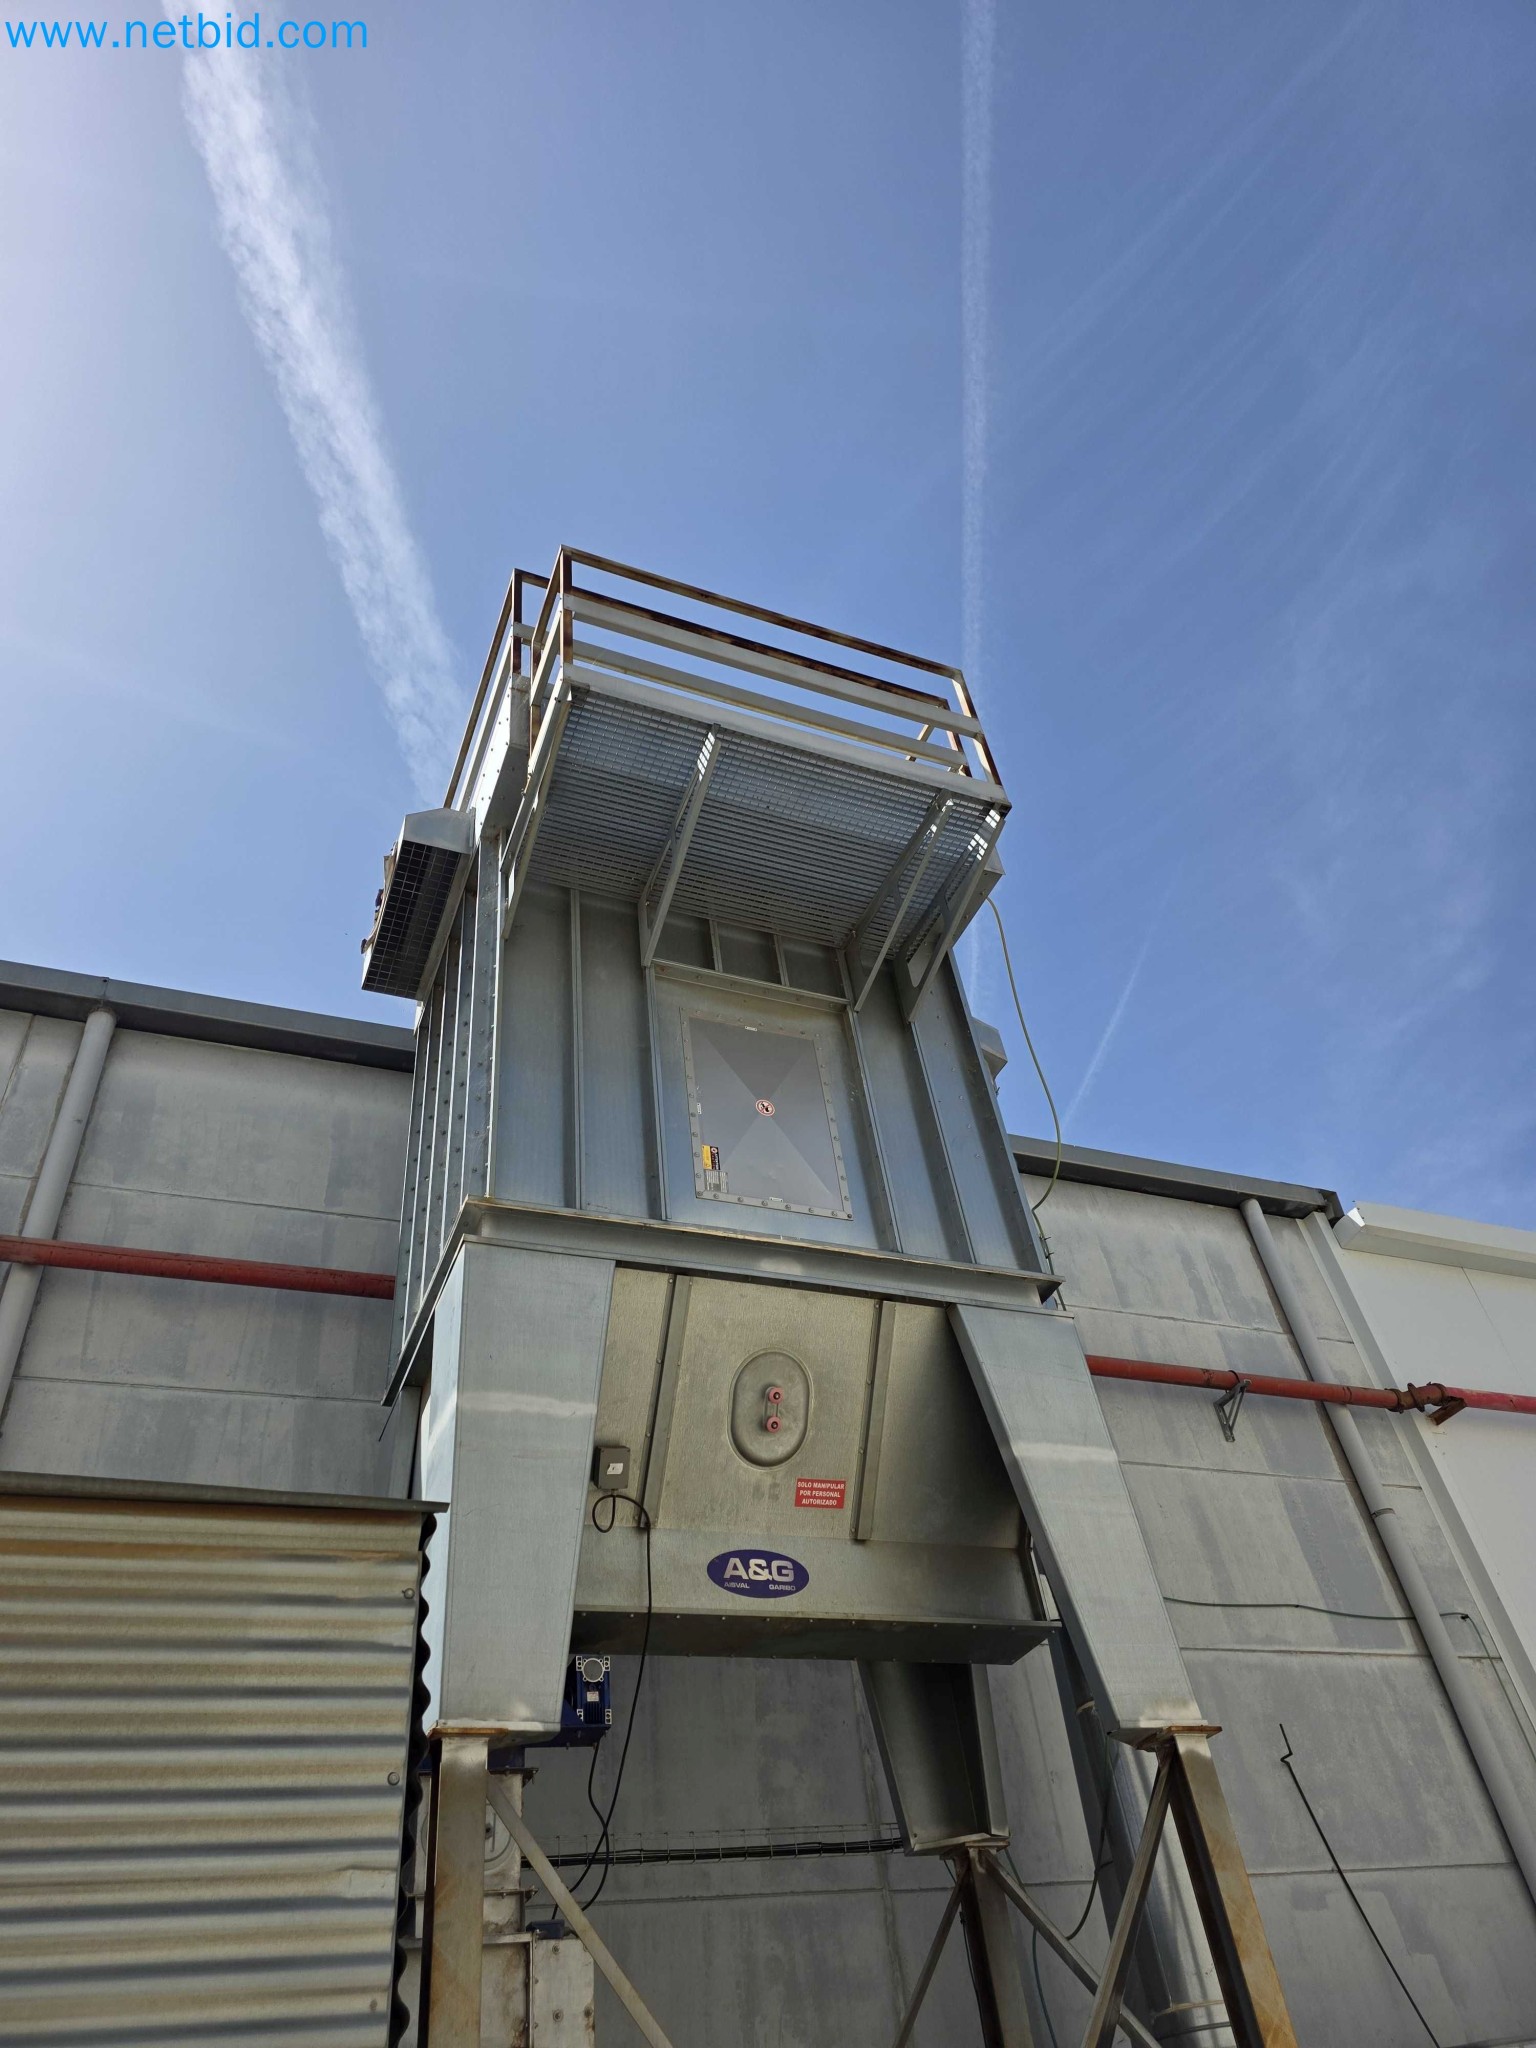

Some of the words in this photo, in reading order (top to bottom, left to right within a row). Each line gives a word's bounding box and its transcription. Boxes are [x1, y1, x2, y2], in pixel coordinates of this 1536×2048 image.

[813, 1482, 845, 1490] MANIPULAR
[799, 1489, 812, 1497] POR
[812, 1490, 841, 1498] PERSONAL
[801, 1498, 838, 1506] AUTORIZADO
[723, 1557, 795, 1583] A&G
